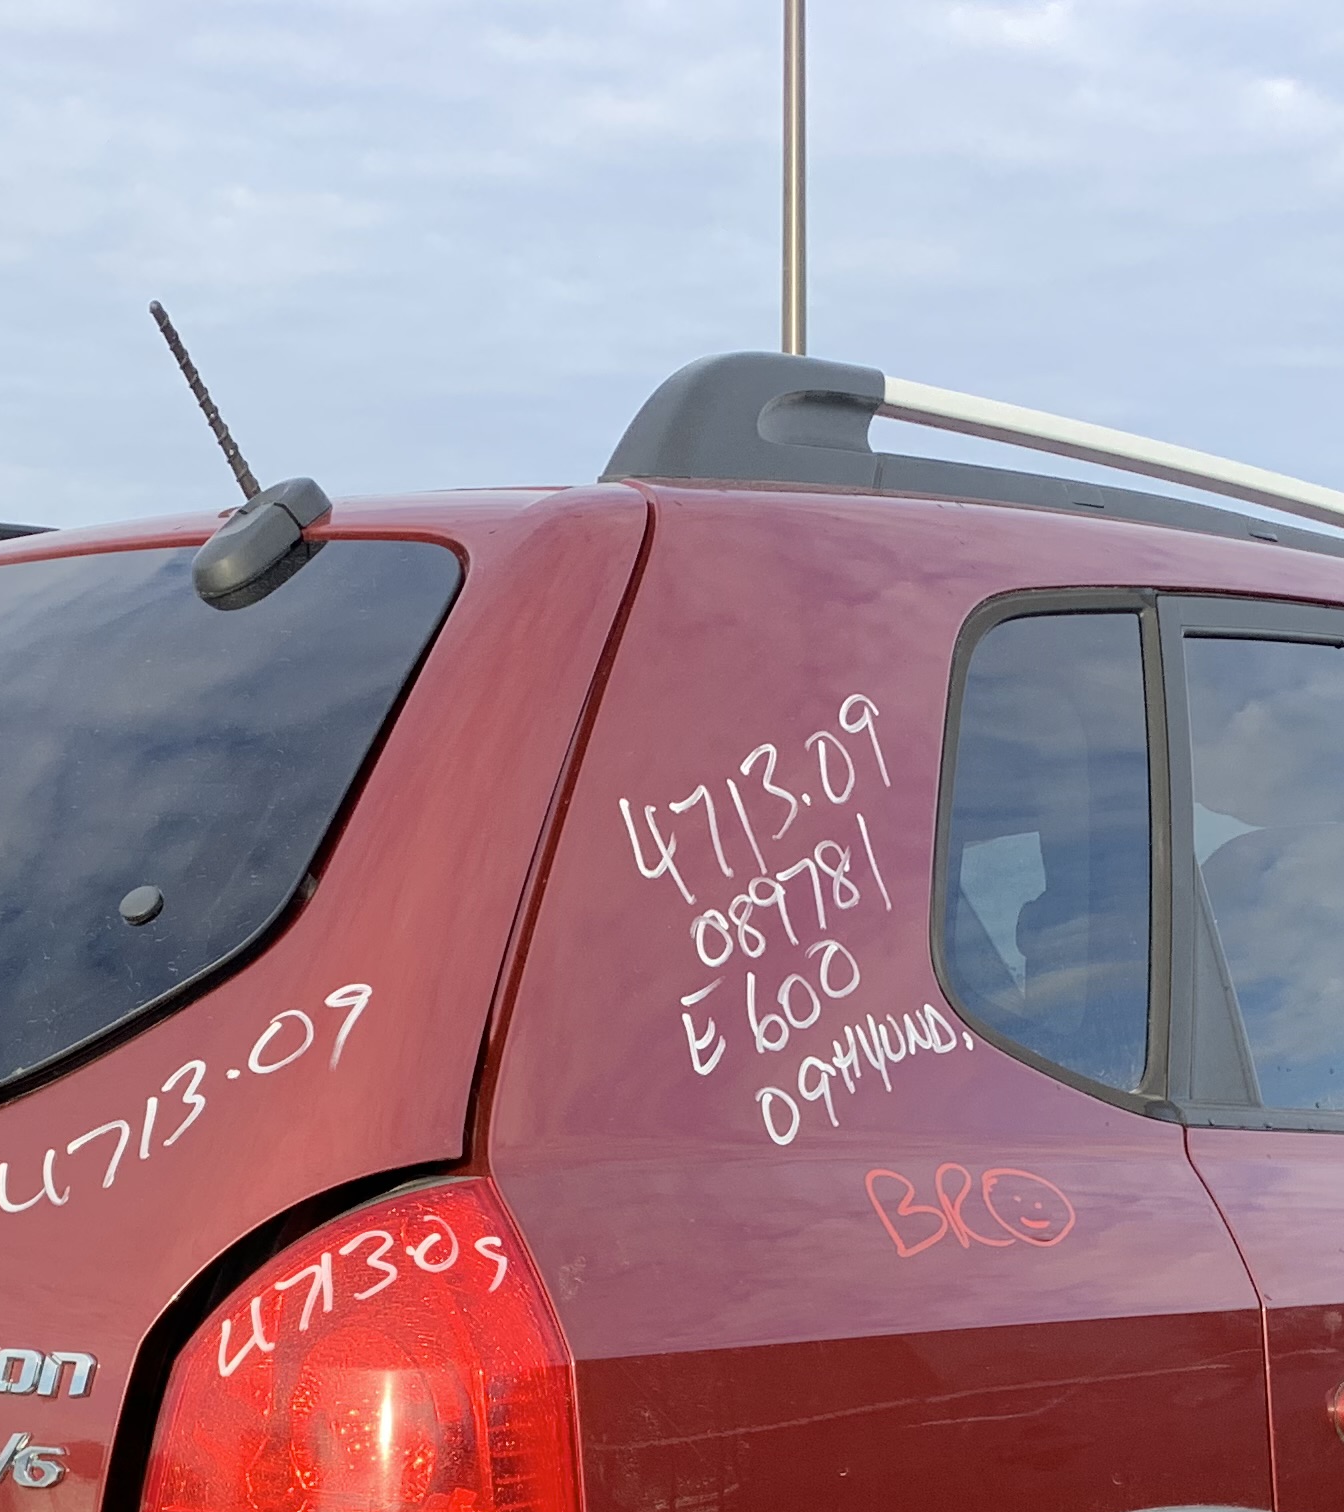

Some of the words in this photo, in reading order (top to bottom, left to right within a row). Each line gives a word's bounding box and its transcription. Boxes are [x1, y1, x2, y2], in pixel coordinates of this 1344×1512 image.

[618, 693, 892, 905] 4713.09
[690, 812, 892, 968] 089781
[680, 975, 726, 1075] E
[746, 939, 861, 1053] 600
